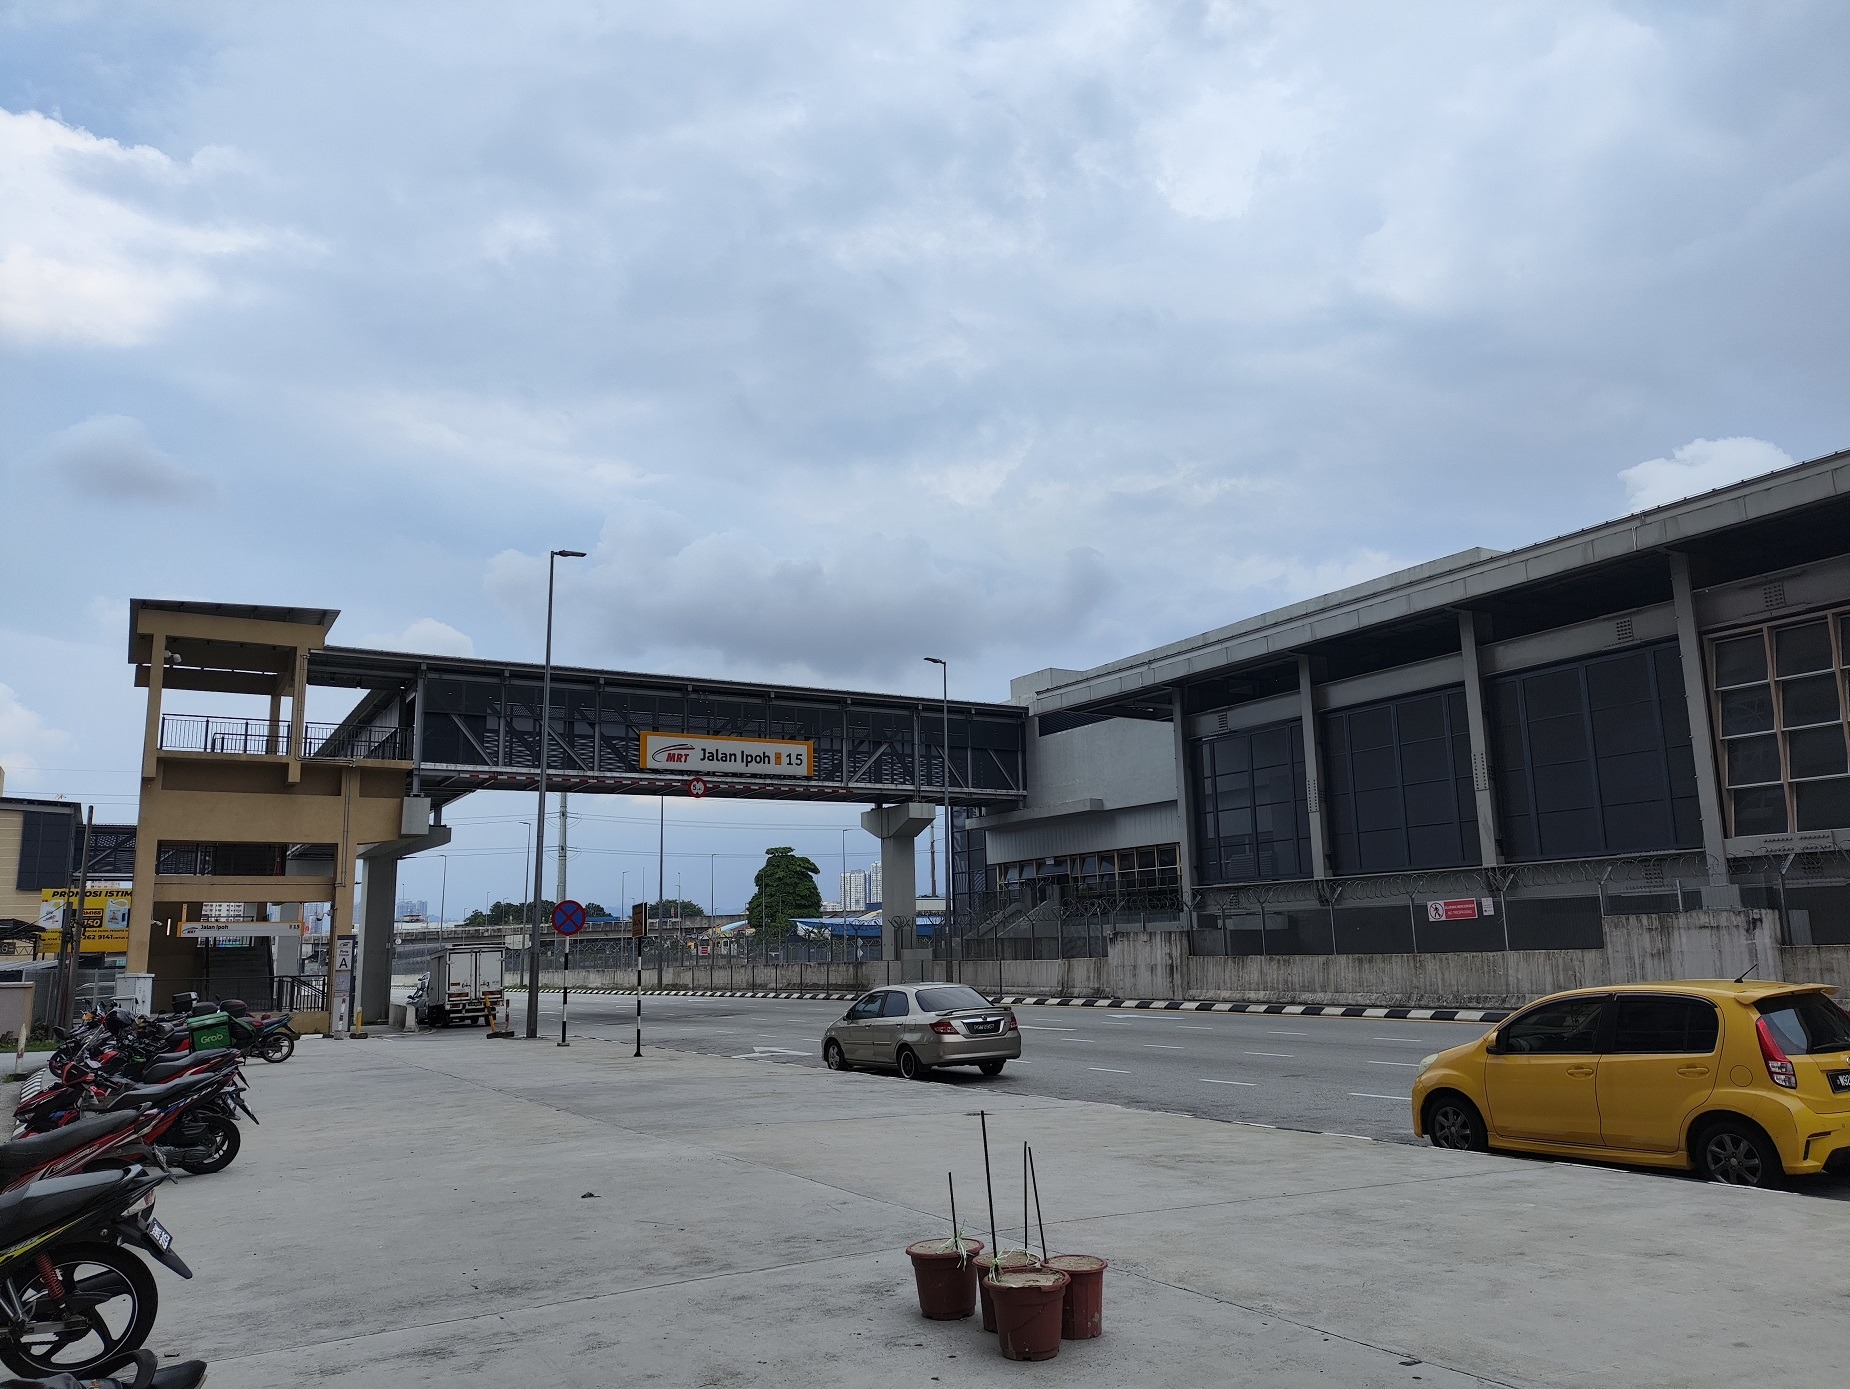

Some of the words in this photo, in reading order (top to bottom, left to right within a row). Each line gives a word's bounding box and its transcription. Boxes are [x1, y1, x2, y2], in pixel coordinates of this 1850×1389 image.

[666, 753, 689, 763] MRT
[700, 748, 737, 763] Jalan
[741, 750, 771, 767] Ipoh
[786, 753, 803, 766] 15
[338, 957, 348, 969] A
[200, 1033, 223, 1043] Grab
